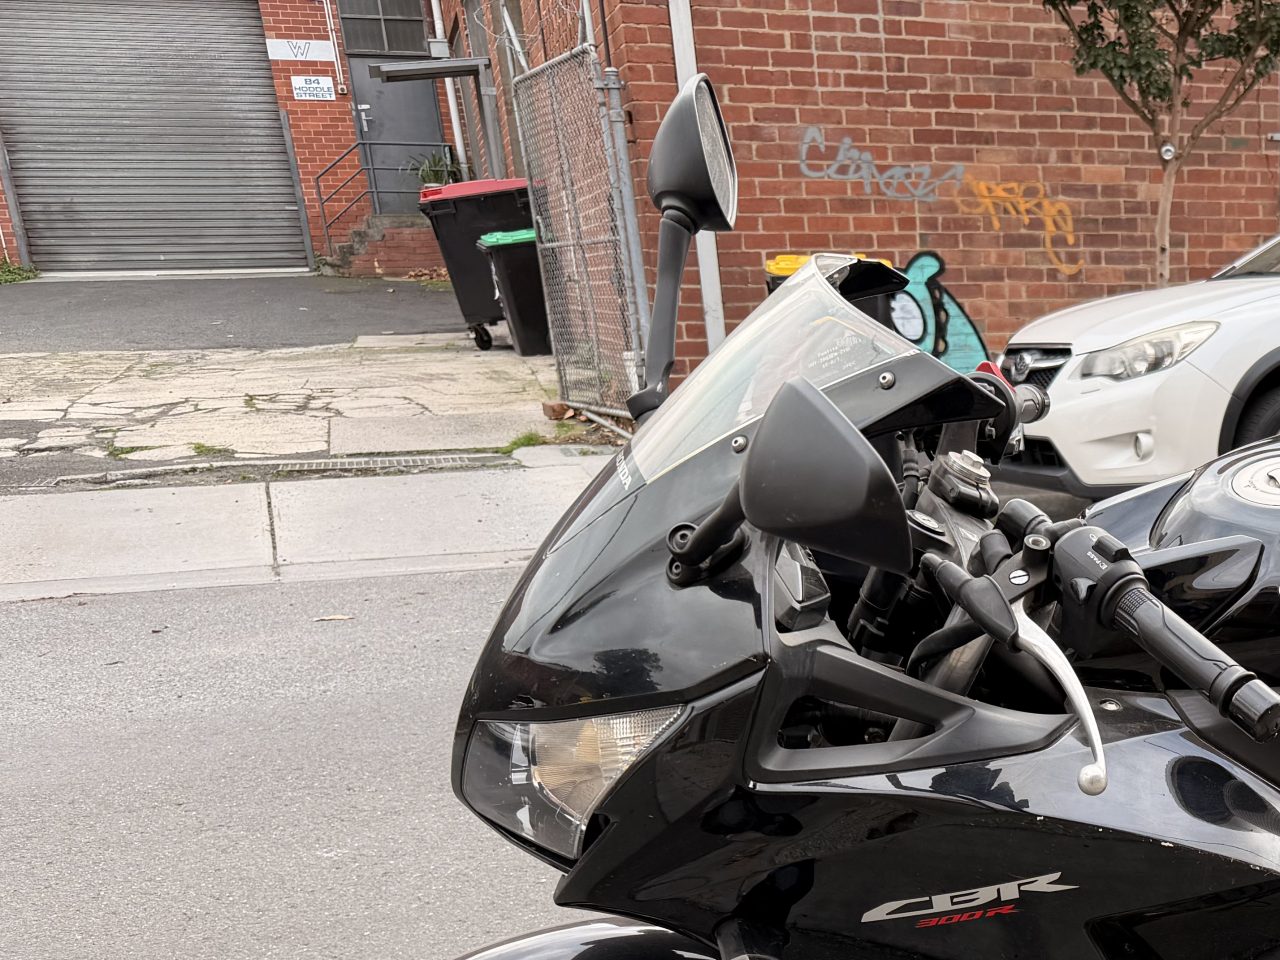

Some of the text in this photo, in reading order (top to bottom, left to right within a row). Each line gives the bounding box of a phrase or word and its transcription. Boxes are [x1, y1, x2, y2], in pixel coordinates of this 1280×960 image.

[286, 40, 311, 59] W
[861, 871, 1081, 923] CBR
[915, 904, 1024, 929] 300R
